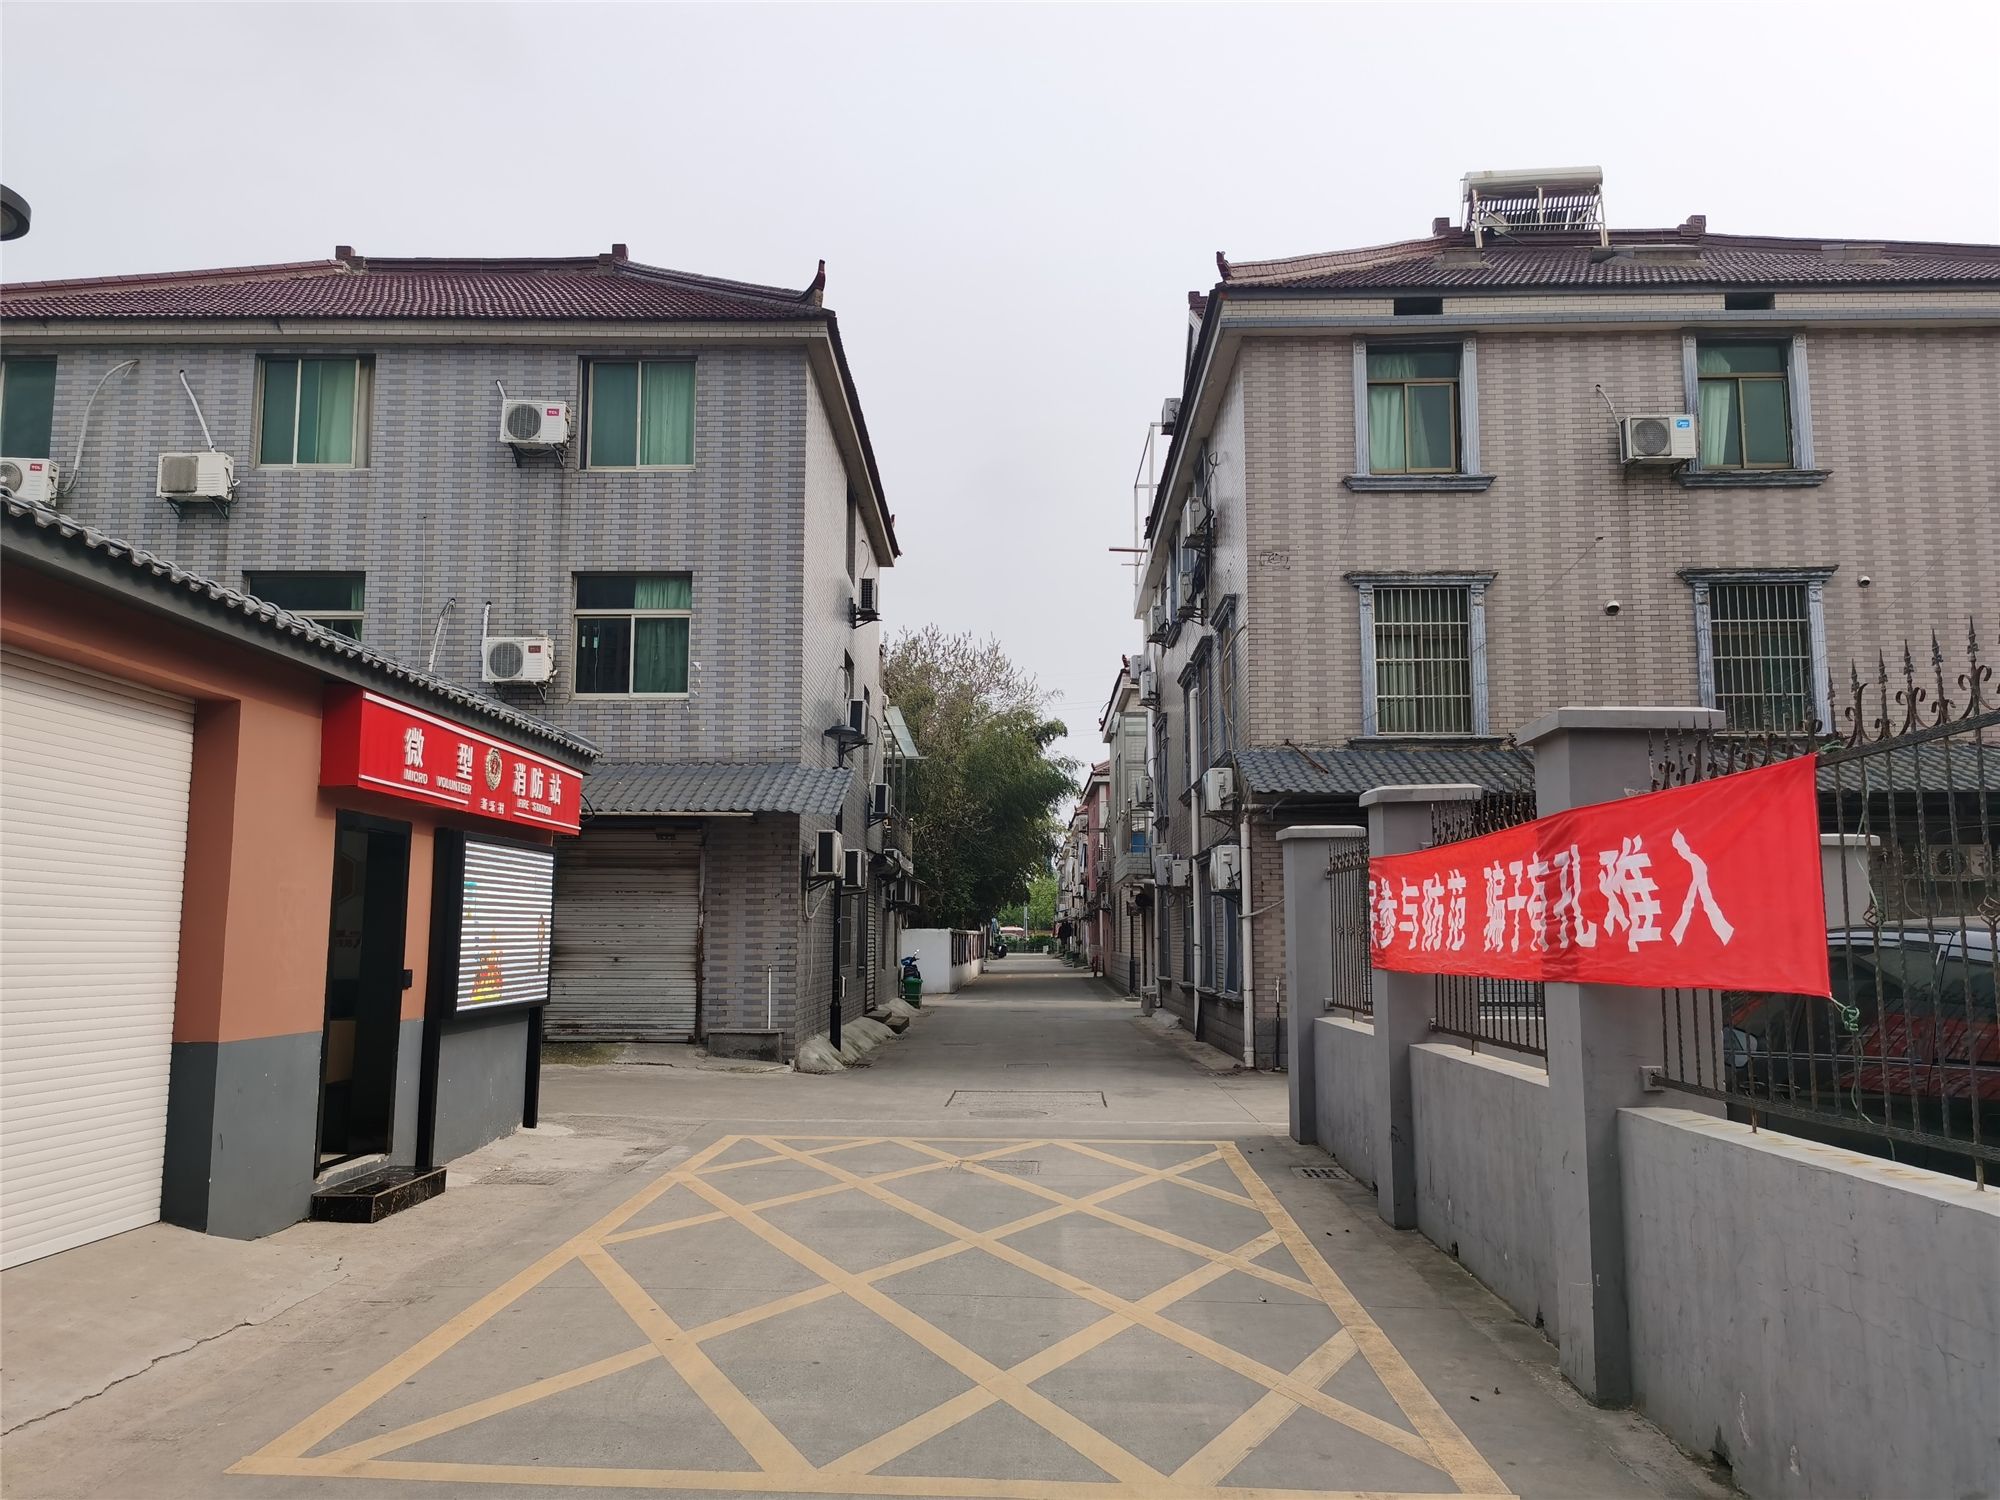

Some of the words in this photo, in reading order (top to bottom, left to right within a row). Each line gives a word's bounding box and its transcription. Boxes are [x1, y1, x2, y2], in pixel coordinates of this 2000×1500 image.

[404, 727, 474, 780] 微型
[513, 762, 561, 805] 消防站
[404, 768, 428, 785] MICRO
[436, 775, 472, 795] VOLUNTEER
[1483, 828, 1735, 953] 骗子有孔难入
